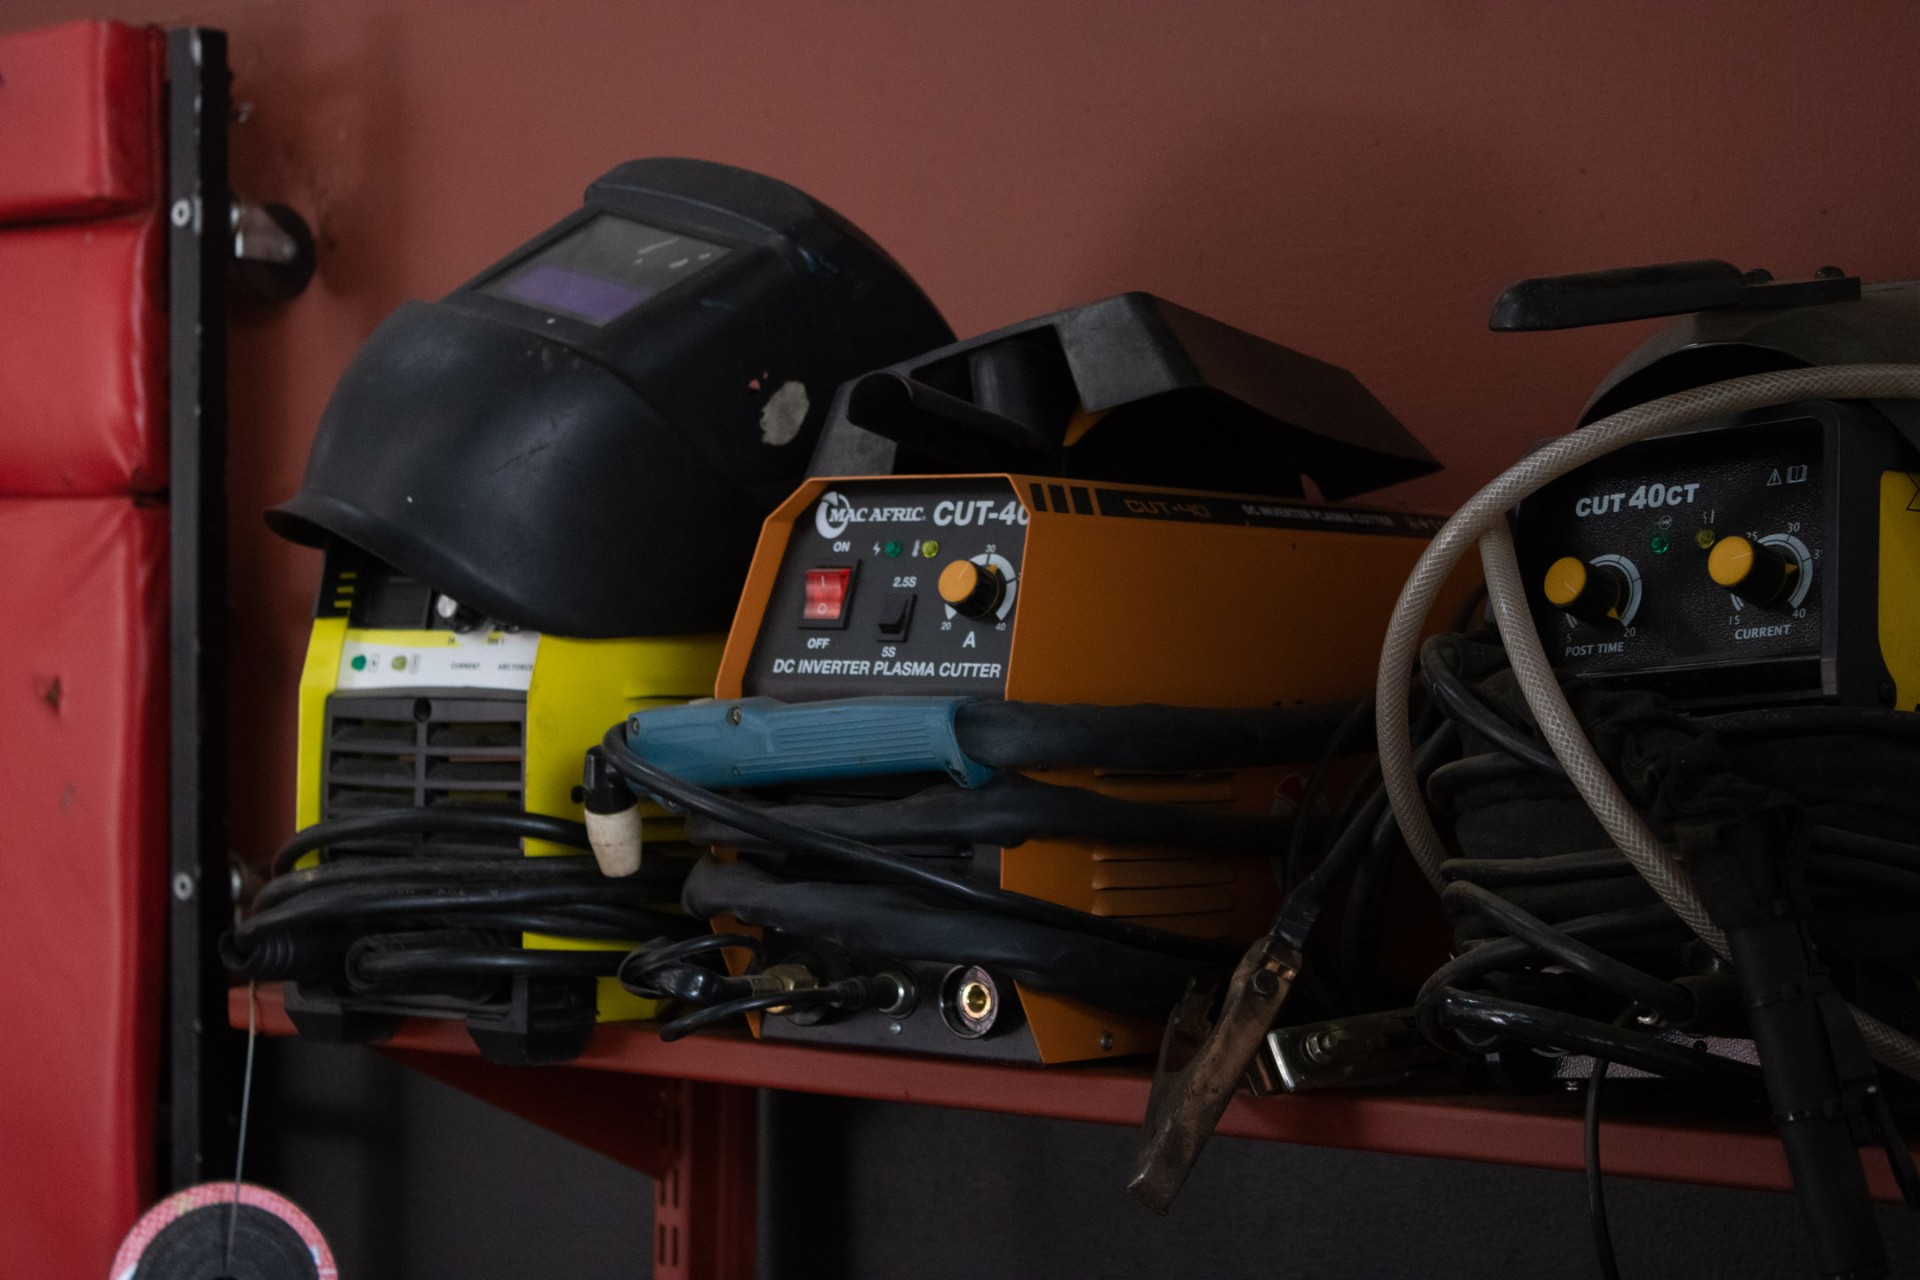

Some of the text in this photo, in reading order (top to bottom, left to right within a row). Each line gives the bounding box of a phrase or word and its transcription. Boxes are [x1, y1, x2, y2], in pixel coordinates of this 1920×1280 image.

[1575, 492, 1626, 517] CUT
[829, 506, 924, 522] MAC AFRIC
[1787, 522, 1801, 533] 30
[833, 541, 850, 553] ON
[985, 544, 997, 553] 30
[893, 576, 917, 588] 2.5S
[1792, 608, 1807, 619] 40
[941, 621, 952, 631] 20
[1728, 614, 1741, 626] 15
[995, 622, 1007, 632] 40
[1623, 627, 1637, 638] 20
[1735, 624, 1792, 641] CURRENT
[807, 638, 830, 649] OFF
[962, 631, 976, 648] A
[881, 646, 896, 658] 5S
[1565, 641, 1625, 657] POST TIME
[773, 658, 1002, 678] DC INVERTER PLASMA CUTTER
